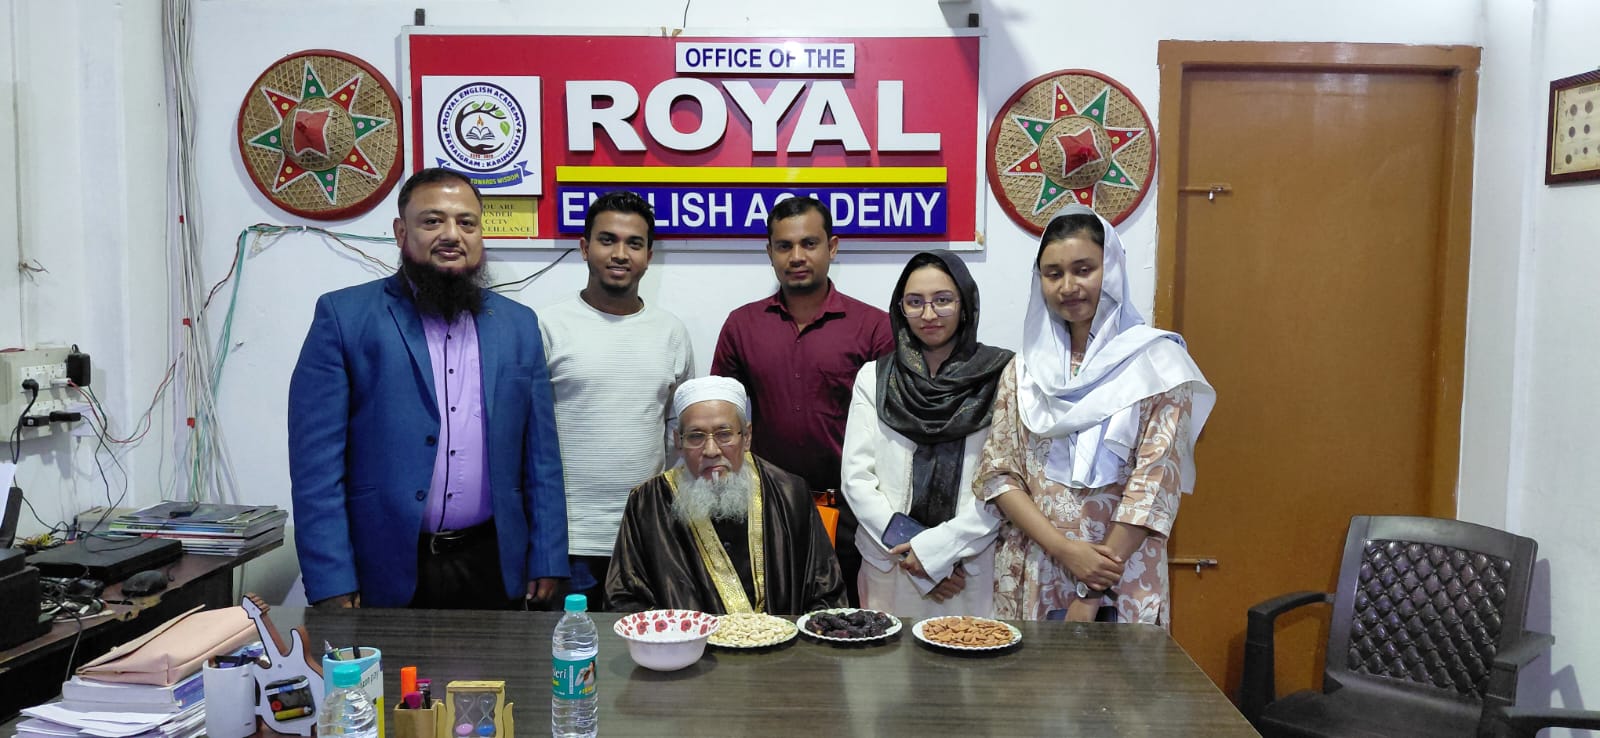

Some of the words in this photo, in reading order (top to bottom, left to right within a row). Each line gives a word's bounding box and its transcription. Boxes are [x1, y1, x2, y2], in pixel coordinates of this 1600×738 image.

[685, 48, 762, 68] OFFICE
[769, 48, 796, 68] OF
[803, 48, 845, 68] THE
[442, 97, 460, 126] ROYAL
[459, 86, 493, 99] ENGLISH
[494, 90, 522, 128] ACADEMY
[565, 77, 941, 152] ROYAL
[444, 133, 481, 167] BARAIGRAM
[470, 177, 497, 185] TOWARDS
[497, 172, 520, 184] WISDOM
[562, 192, 733, 227] ELISH
[744, 192, 941, 227] ADEMY
